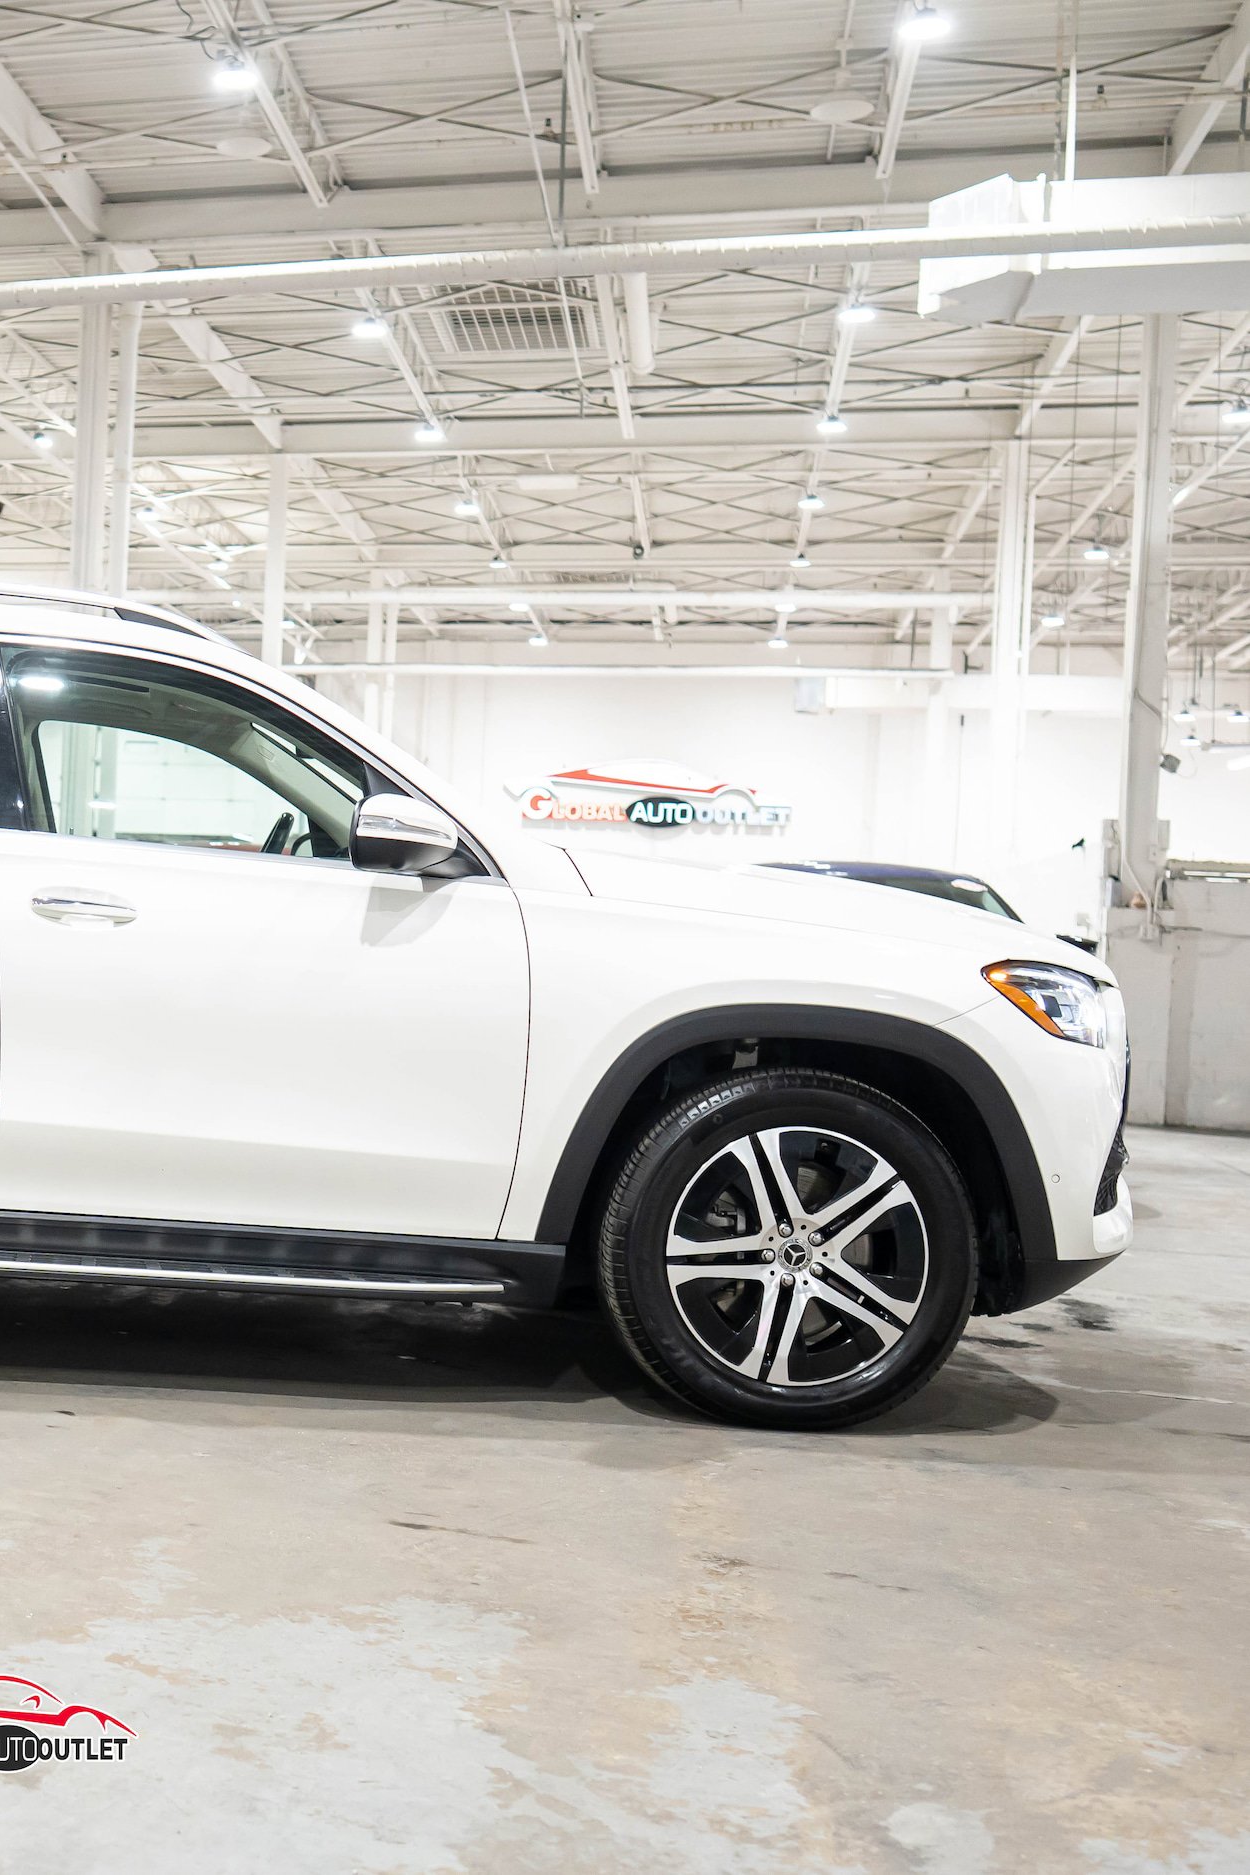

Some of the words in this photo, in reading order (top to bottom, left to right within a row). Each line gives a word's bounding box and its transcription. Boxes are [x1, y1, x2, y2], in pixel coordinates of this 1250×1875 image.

[521, 787, 627, 823] GLOBAL
[629, 801, 695, 825] AUTO
[695, 806, 791, 827] OUTLET
